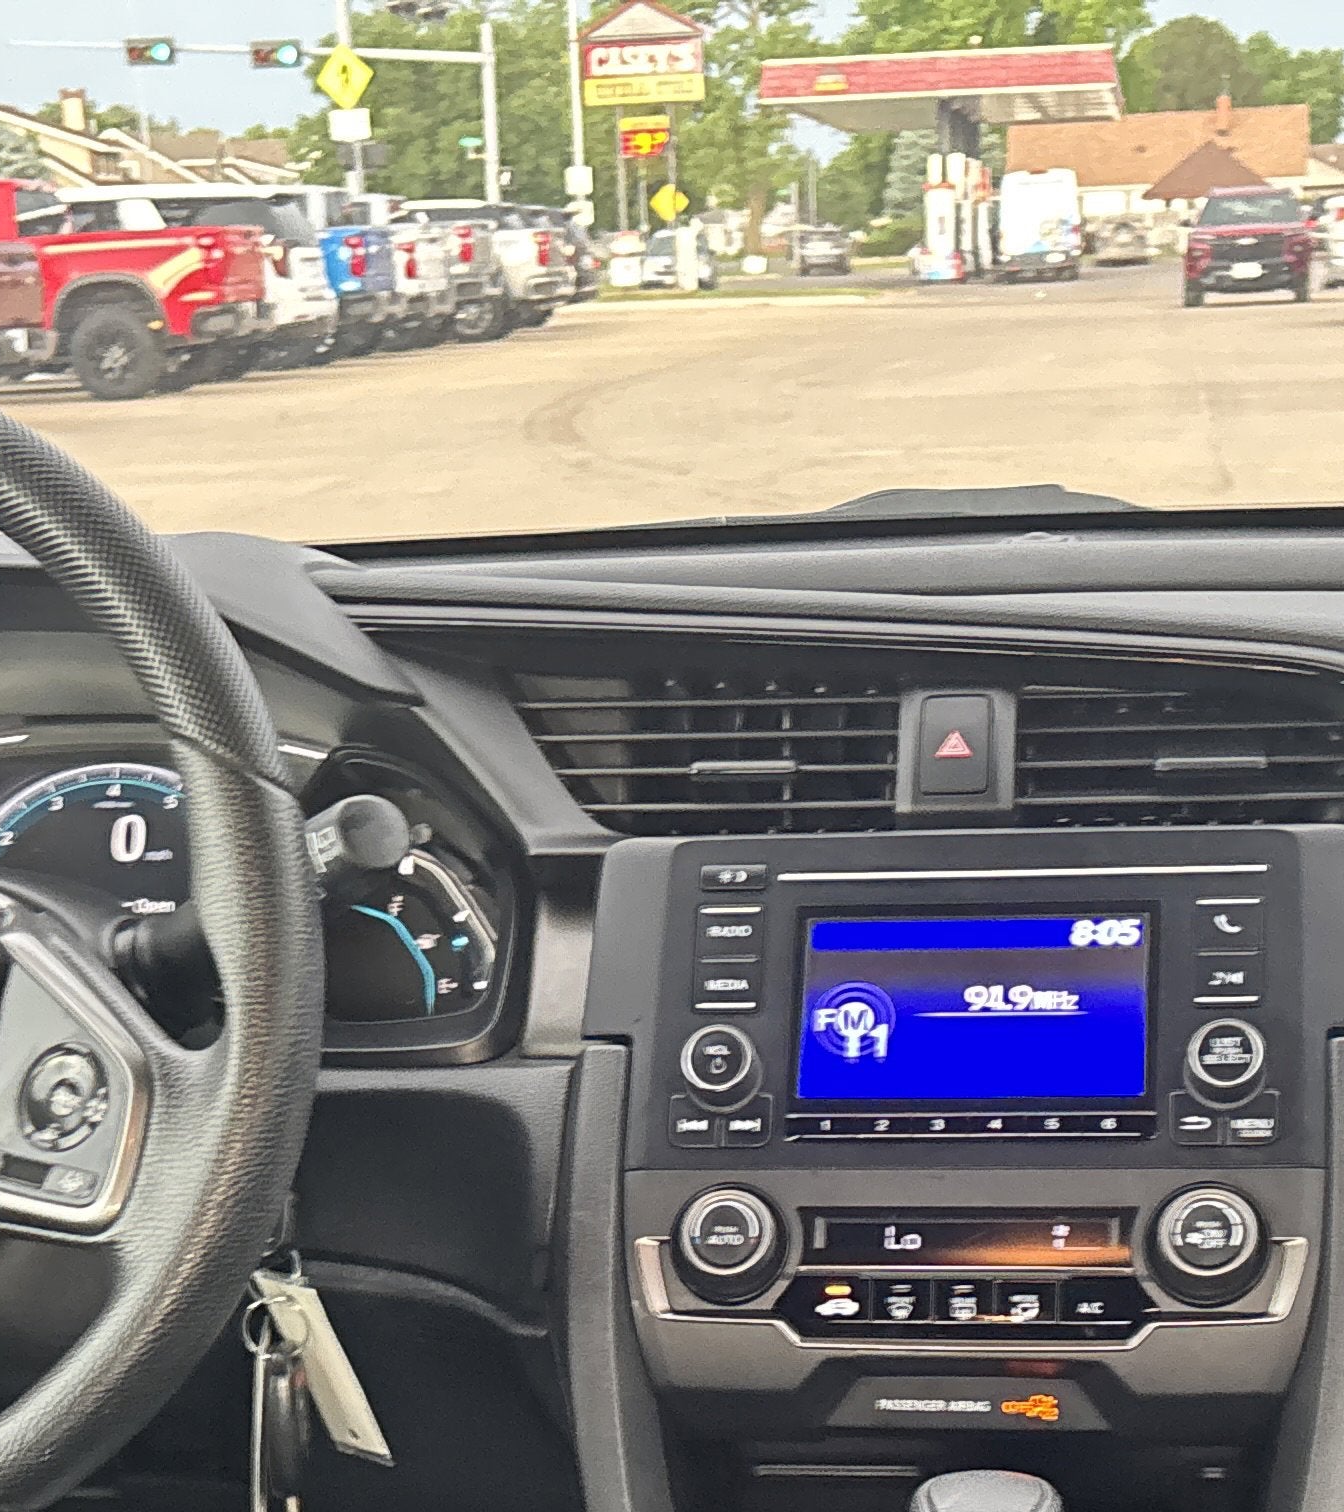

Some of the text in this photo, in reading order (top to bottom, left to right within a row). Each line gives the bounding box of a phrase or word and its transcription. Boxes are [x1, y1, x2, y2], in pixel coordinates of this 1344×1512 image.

[48, 795, 65, 811] 3
[110, 813, 148, 863] 0
[1068, 918, 1142, 947] 8:05
